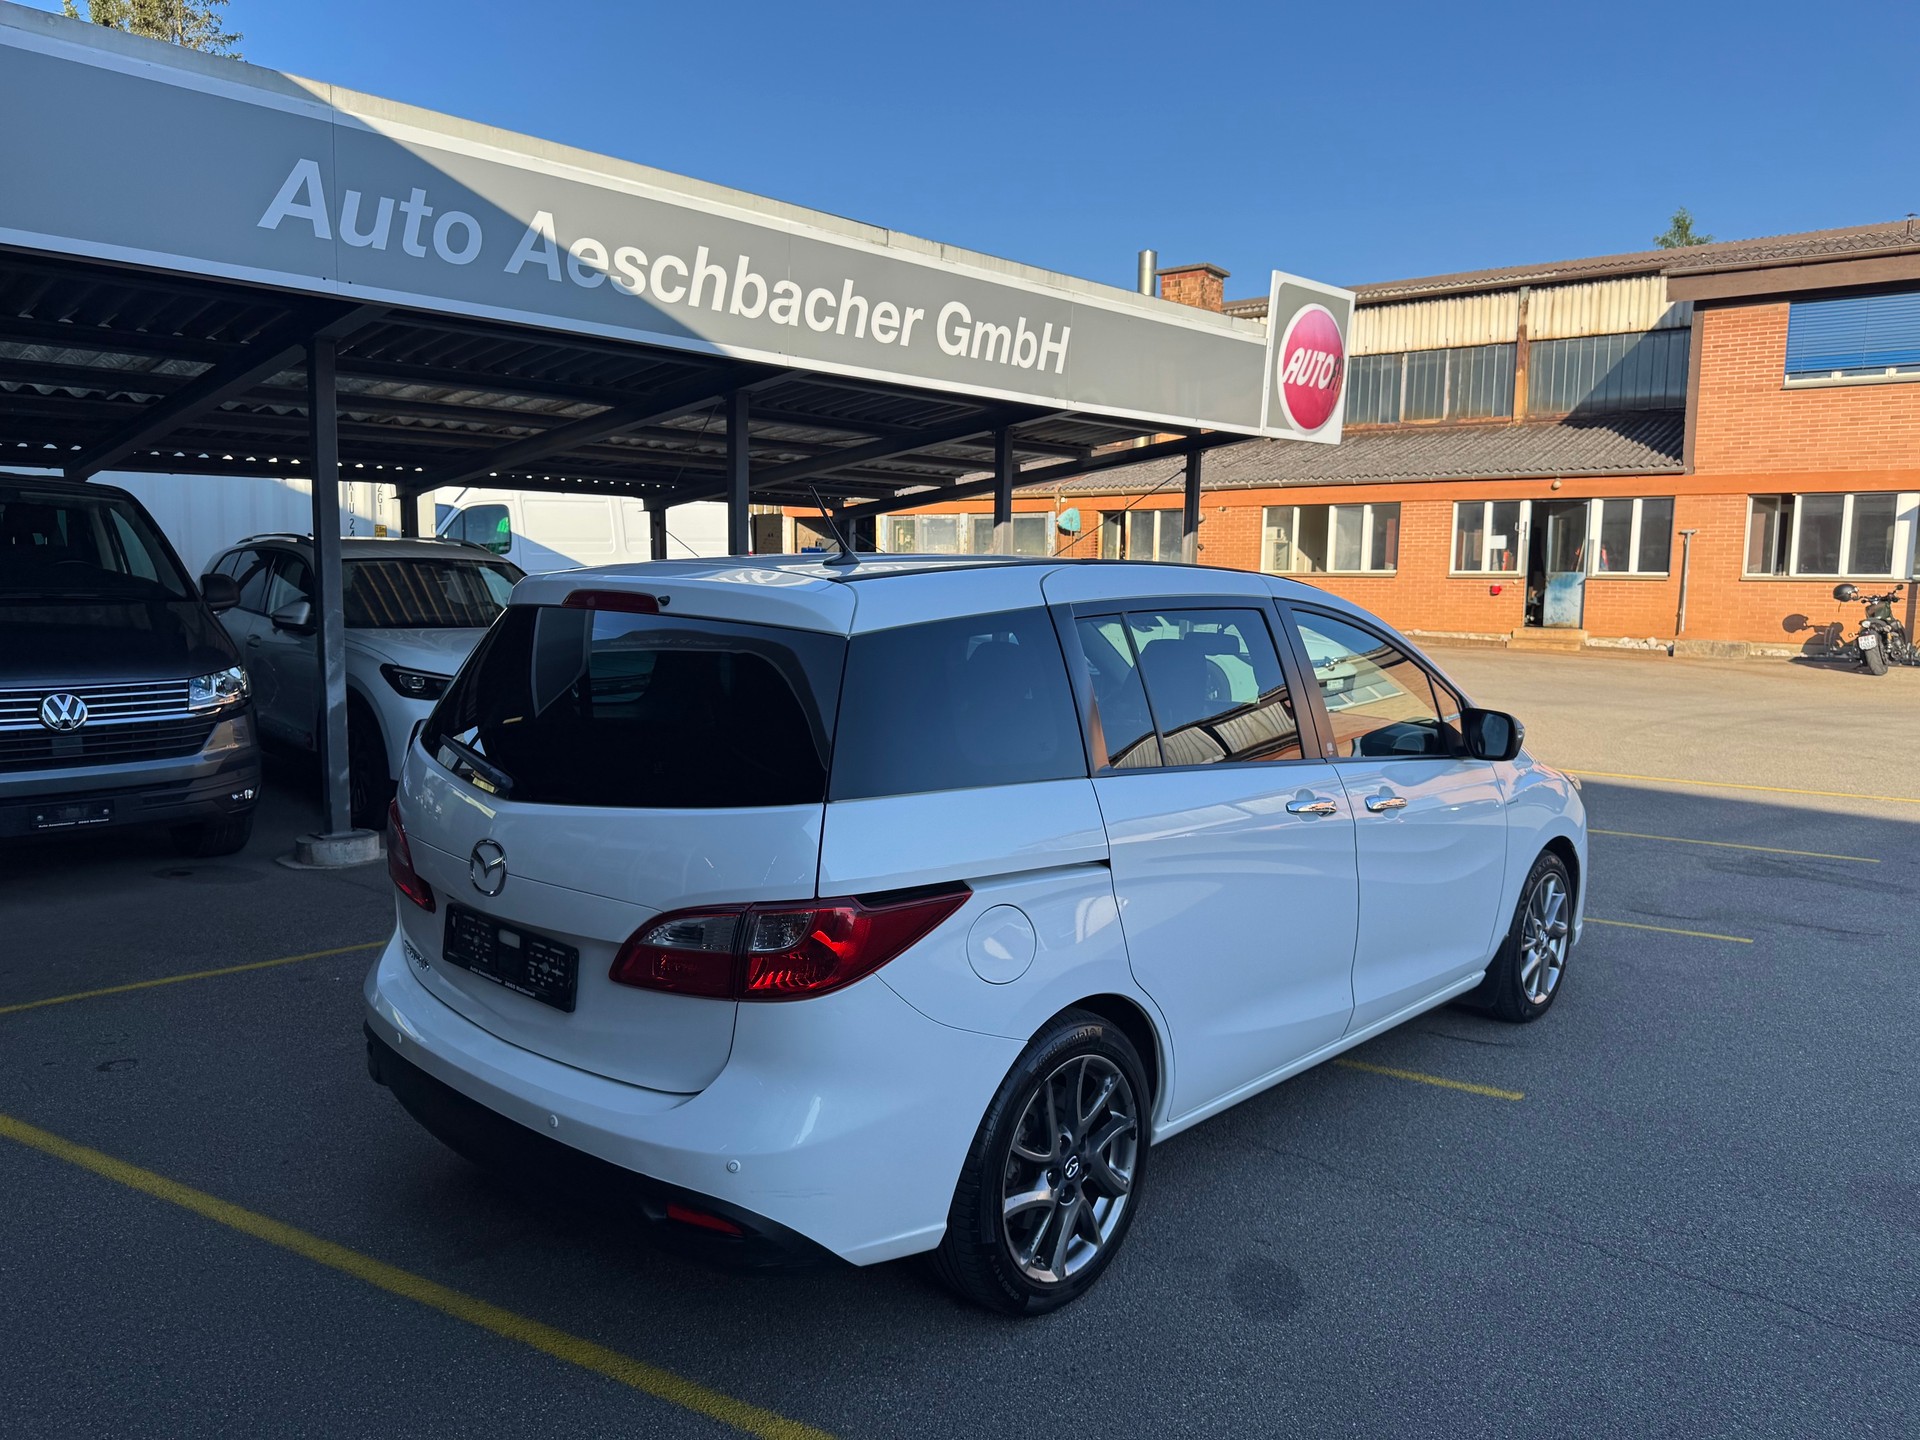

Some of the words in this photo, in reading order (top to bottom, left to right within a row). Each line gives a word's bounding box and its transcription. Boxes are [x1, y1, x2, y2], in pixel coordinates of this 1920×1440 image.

[257, 158, 482, 265] Auto
[504, 210, 925, 347] Aeschbacher
[936, 300, 1071, 374] GmbH
